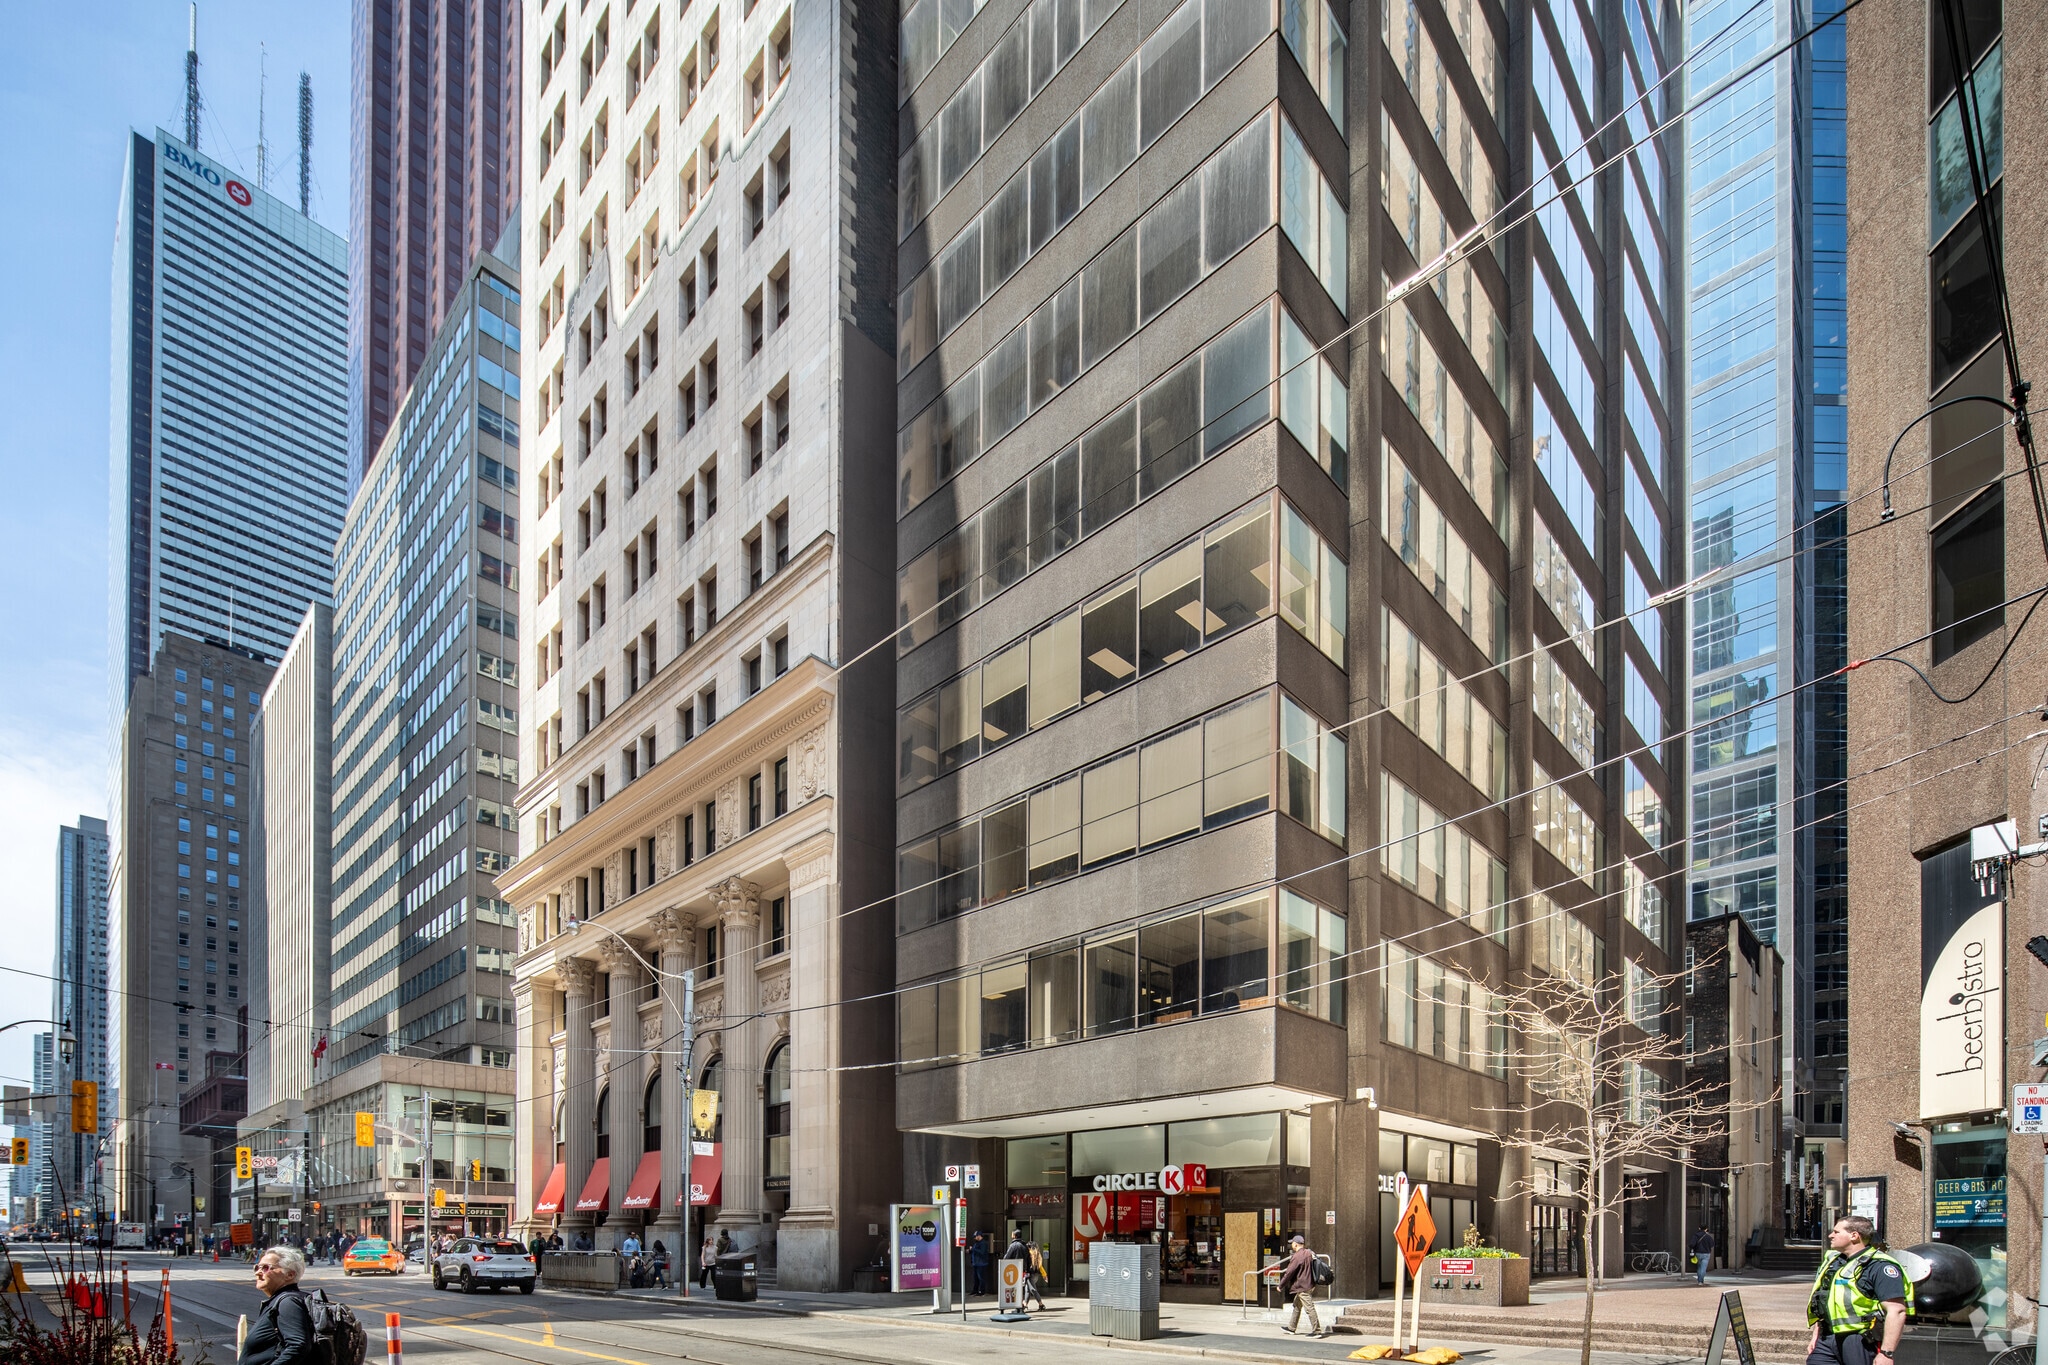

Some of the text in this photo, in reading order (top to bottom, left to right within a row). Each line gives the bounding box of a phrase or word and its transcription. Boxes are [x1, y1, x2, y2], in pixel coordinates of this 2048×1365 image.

[163, 142, 221, 187] BMO
[1936, 941, 1990, 1077] beerbistro
[2028, 1086, 2038, 1095] NO
[2016, 1097, 2048, 1106] STANDING
[1092, 1170, 1181, 1192] CIRCLE K
[1378, 1174, 1394, 1192] CLE
[1938, 1182, 1960, 1195] BEER
[1081, 1195, 1105, 1236] K
[120, 1226, 144, 1234] FedEx
[902, 1225, 920, 1236] 93.5
